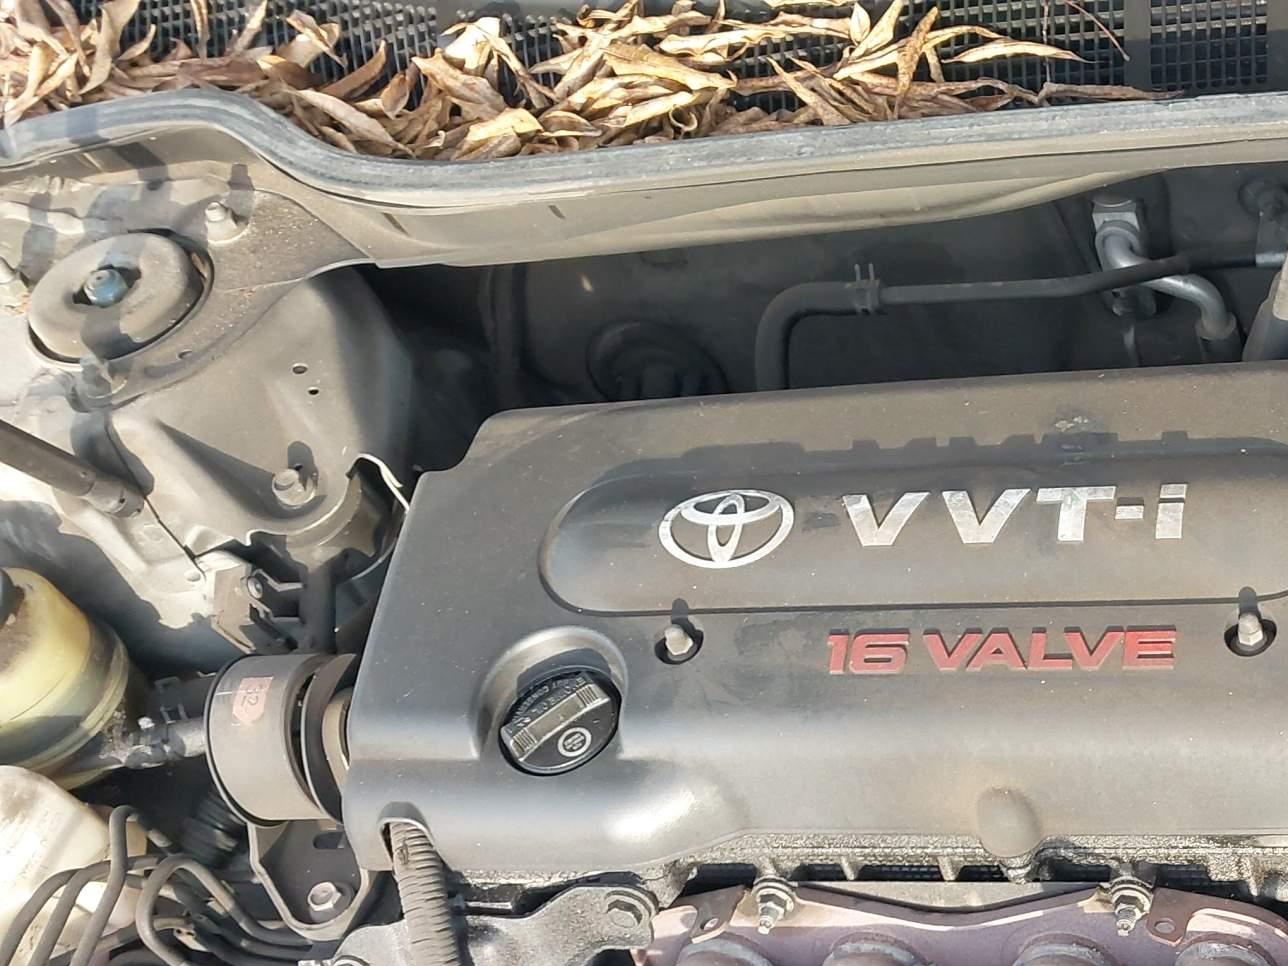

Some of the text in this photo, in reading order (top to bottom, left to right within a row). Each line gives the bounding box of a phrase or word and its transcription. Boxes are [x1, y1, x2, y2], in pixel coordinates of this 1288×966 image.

[842, 483, 1188, 546] VVT-i
[827, 626, 1177, 674] 16 VALVE
